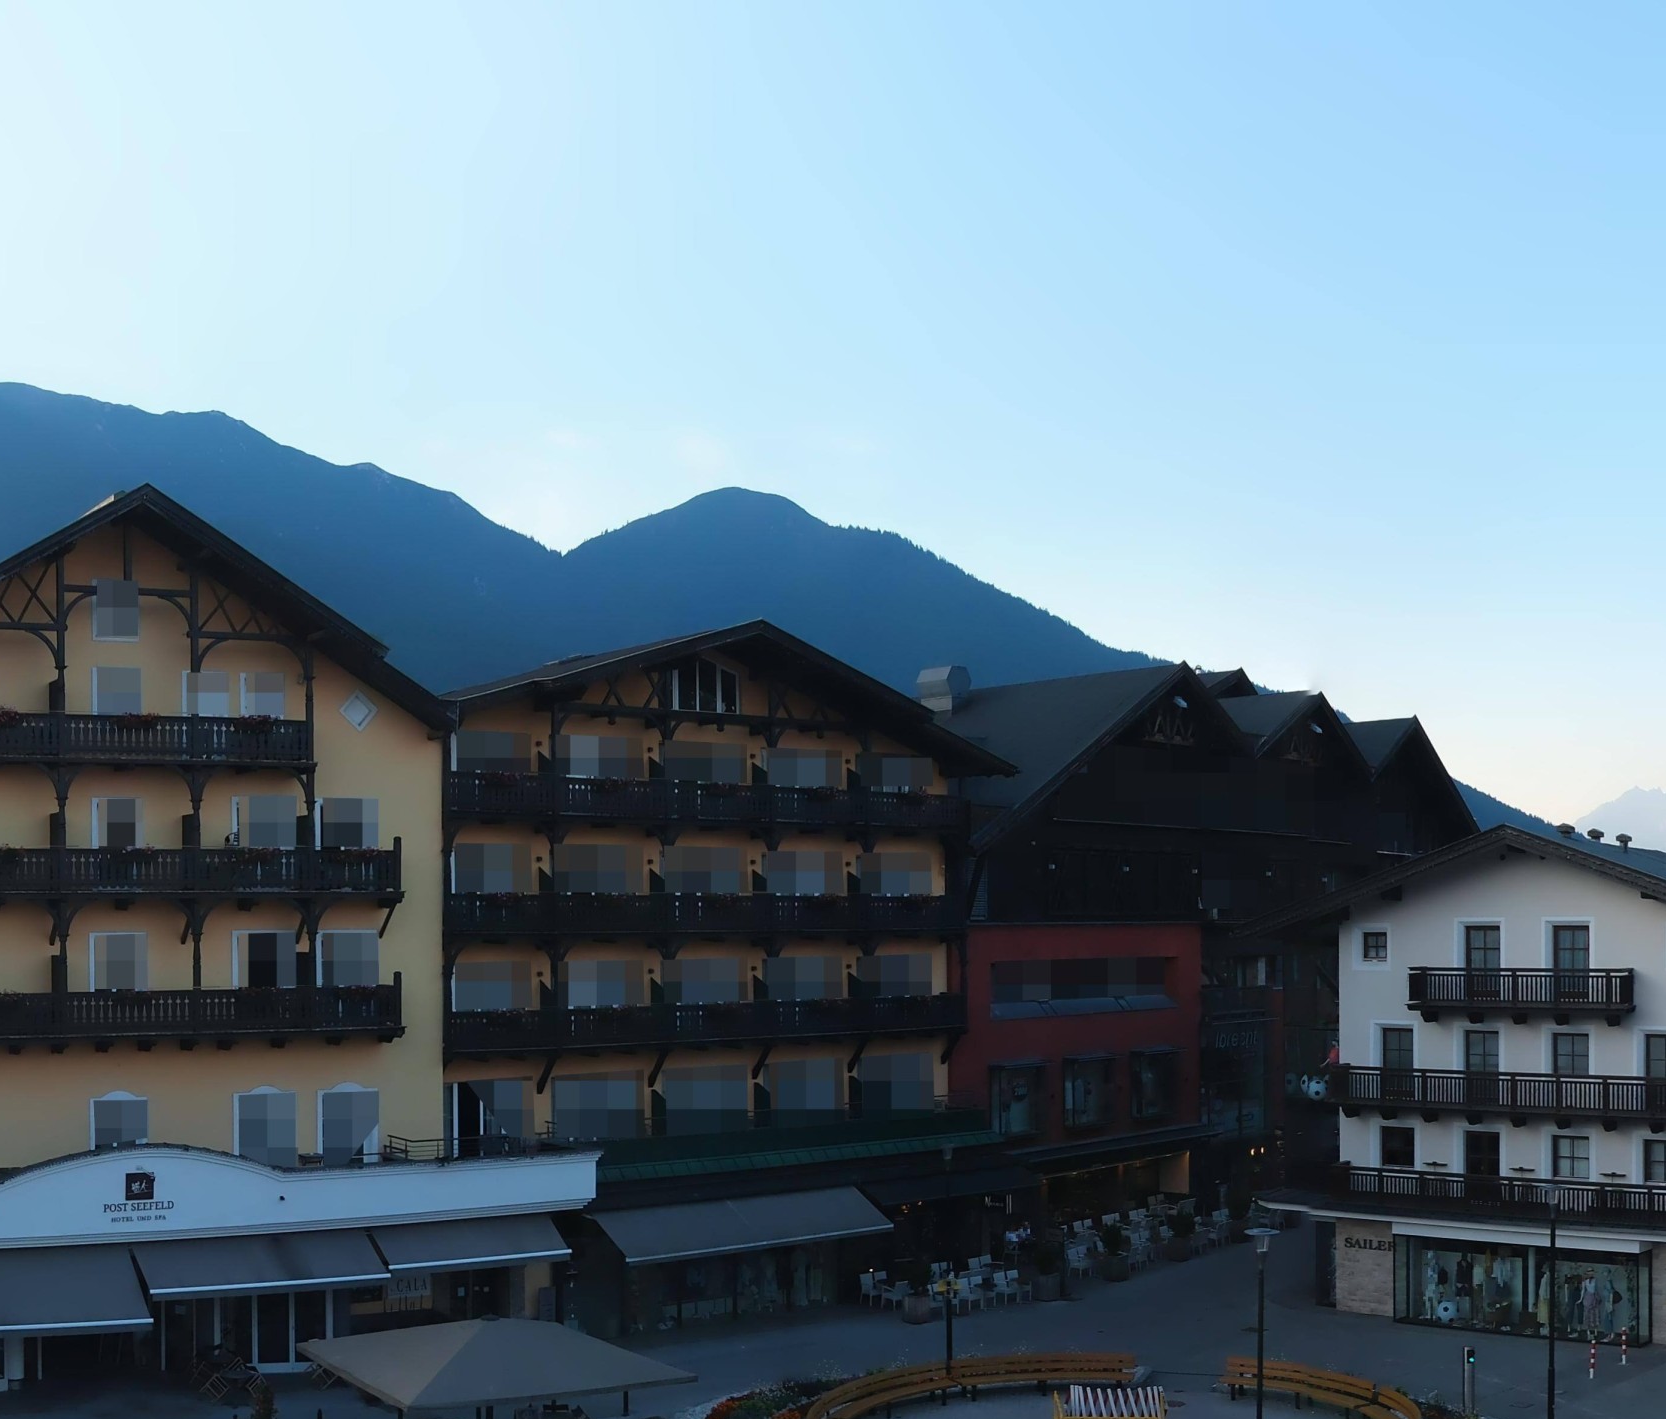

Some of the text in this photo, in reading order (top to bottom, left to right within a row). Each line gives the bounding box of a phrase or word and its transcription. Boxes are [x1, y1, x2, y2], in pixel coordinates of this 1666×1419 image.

[103, 1200, 175, 1213] POST SEEFELD
[1344, 1237, 1397, 1252] SAILER
